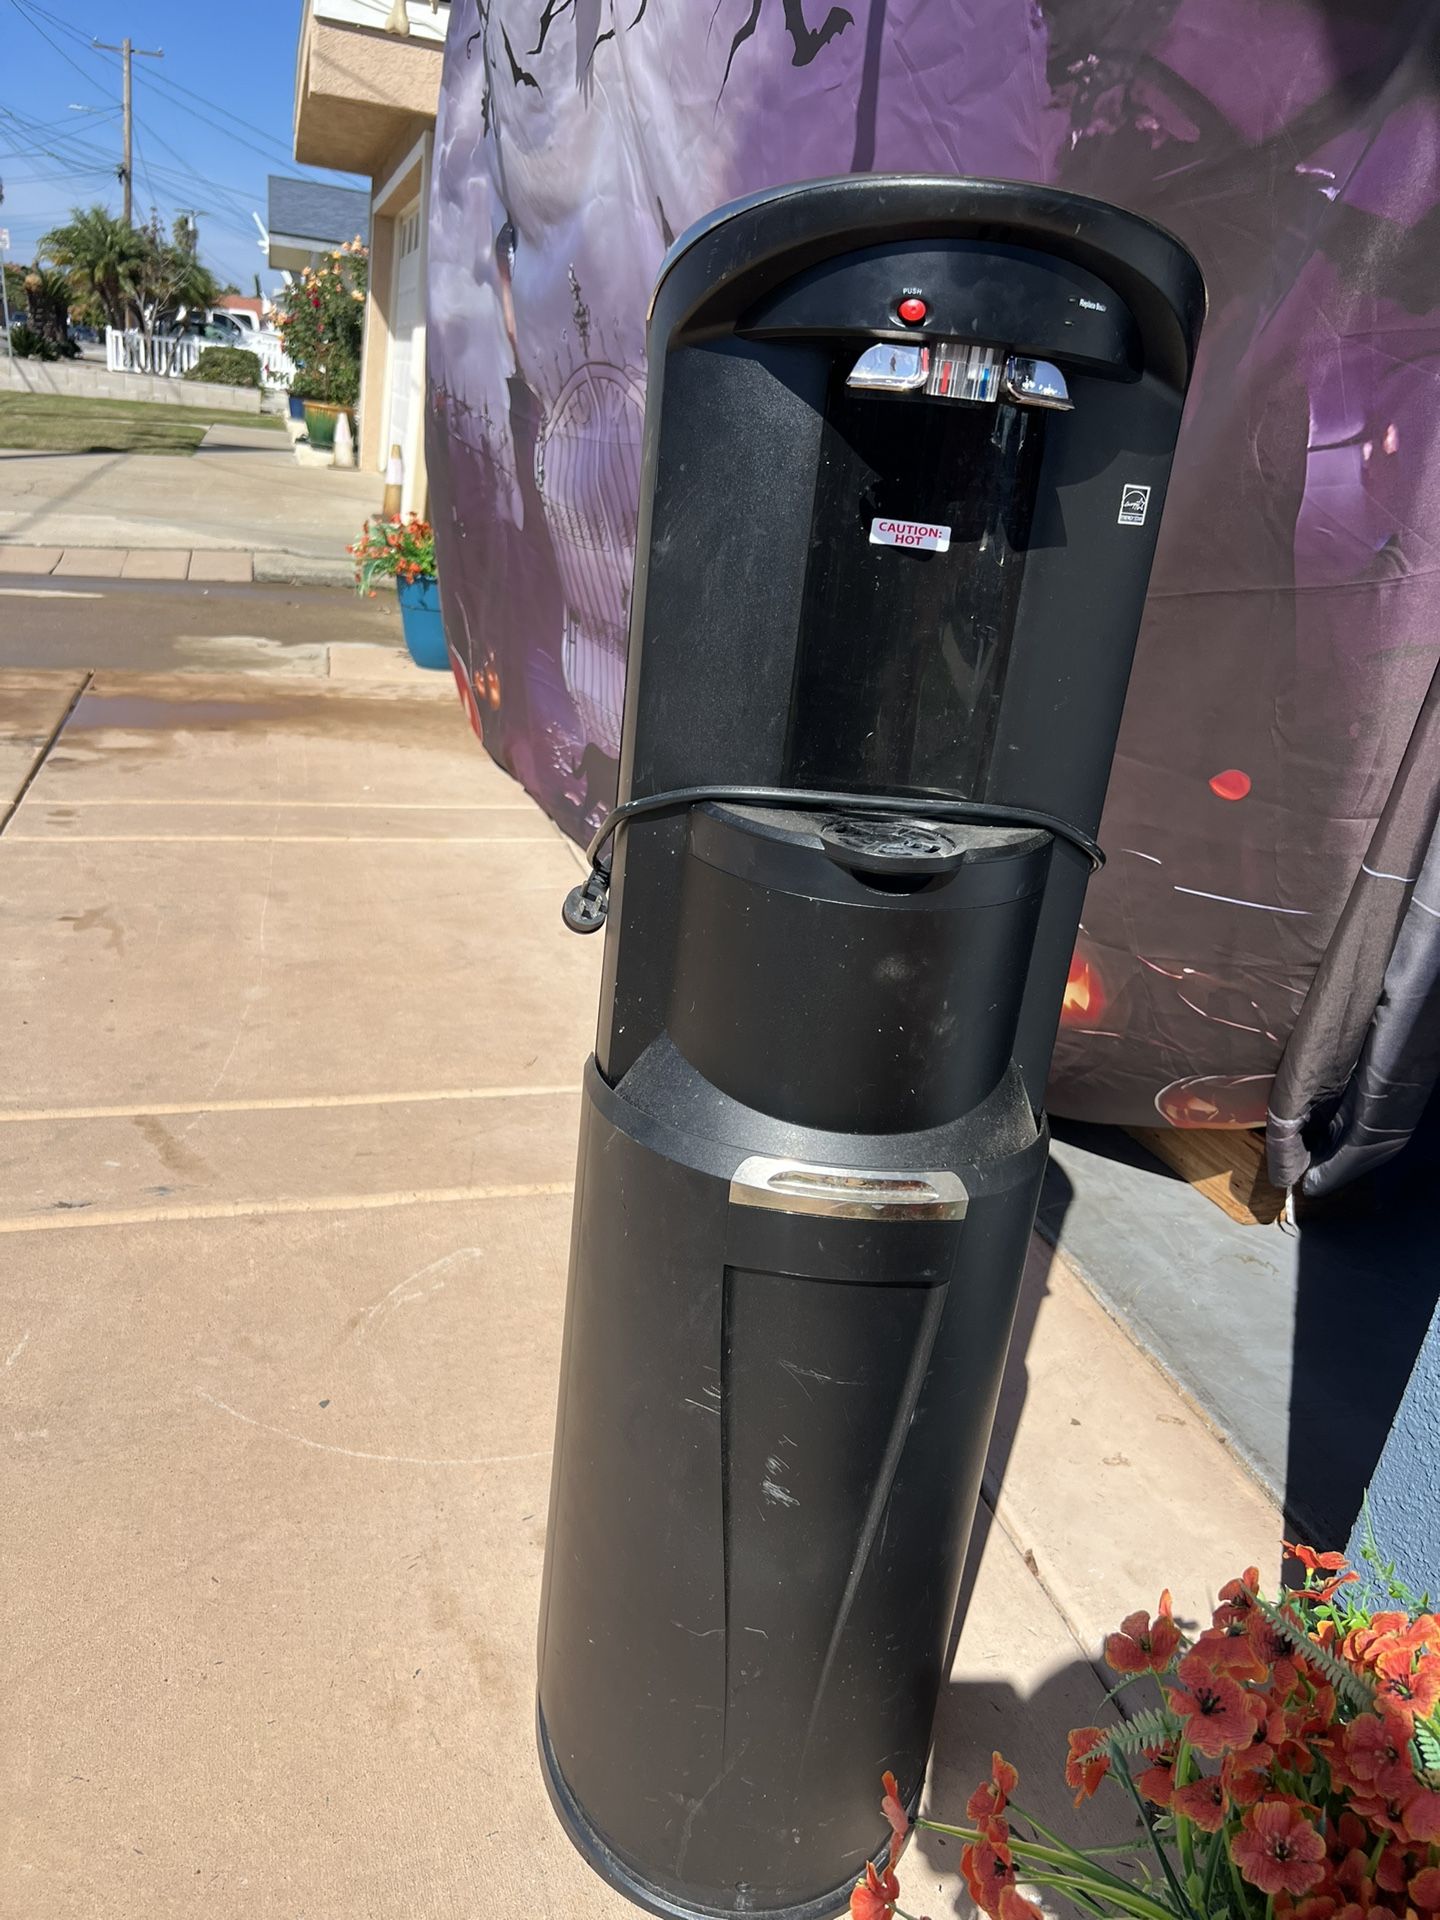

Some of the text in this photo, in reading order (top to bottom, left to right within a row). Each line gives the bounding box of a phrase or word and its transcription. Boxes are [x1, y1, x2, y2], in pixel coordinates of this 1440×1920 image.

[903, 287, 923, 295] PUSH
[878, 521, 943, 538] CAUTION:
[894, 534, 924, 546] HOT
